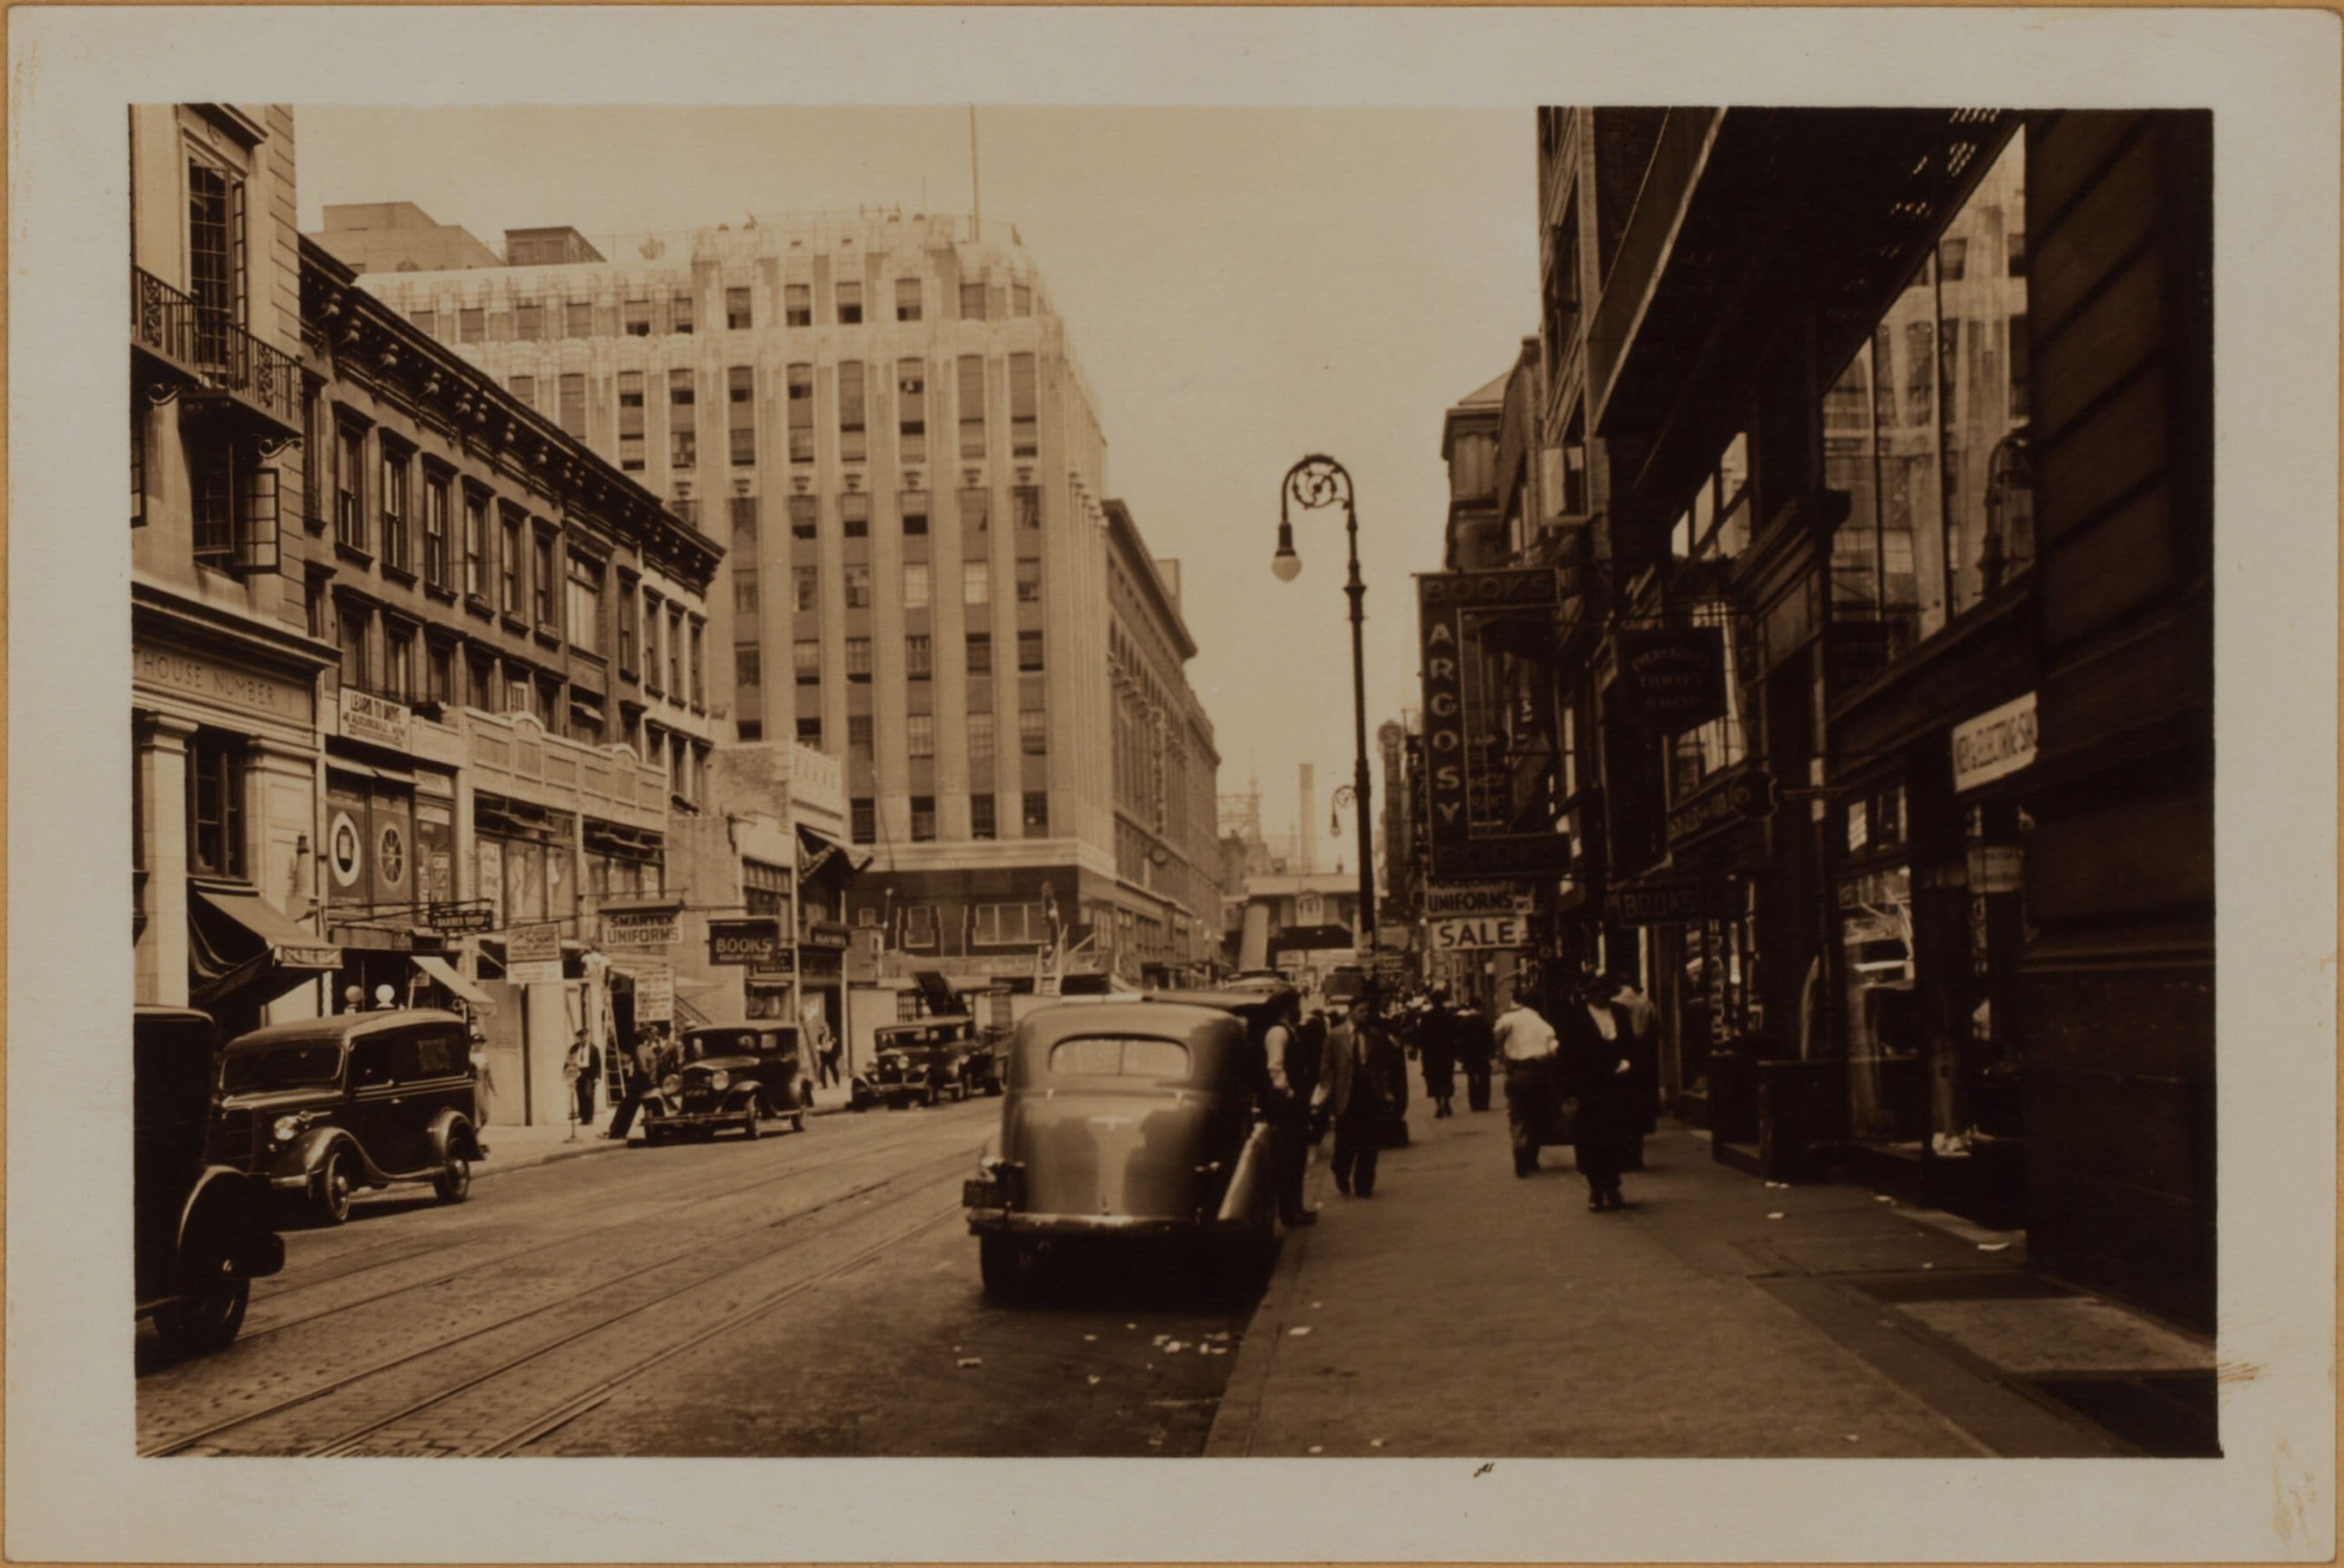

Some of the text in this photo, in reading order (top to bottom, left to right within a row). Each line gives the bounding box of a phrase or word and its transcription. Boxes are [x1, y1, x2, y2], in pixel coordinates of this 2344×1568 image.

[213, 670, 273, 705] NUMBER
[1430, 623, 1461, 825] ARGOSY
[1429, 892, 1512, 913] UNIFORMS
[608, 927, 679, 944] UNIFORMS
[716, 938, 773, 953] BOOKS
[1439, 922, 1516, 948] SALE
